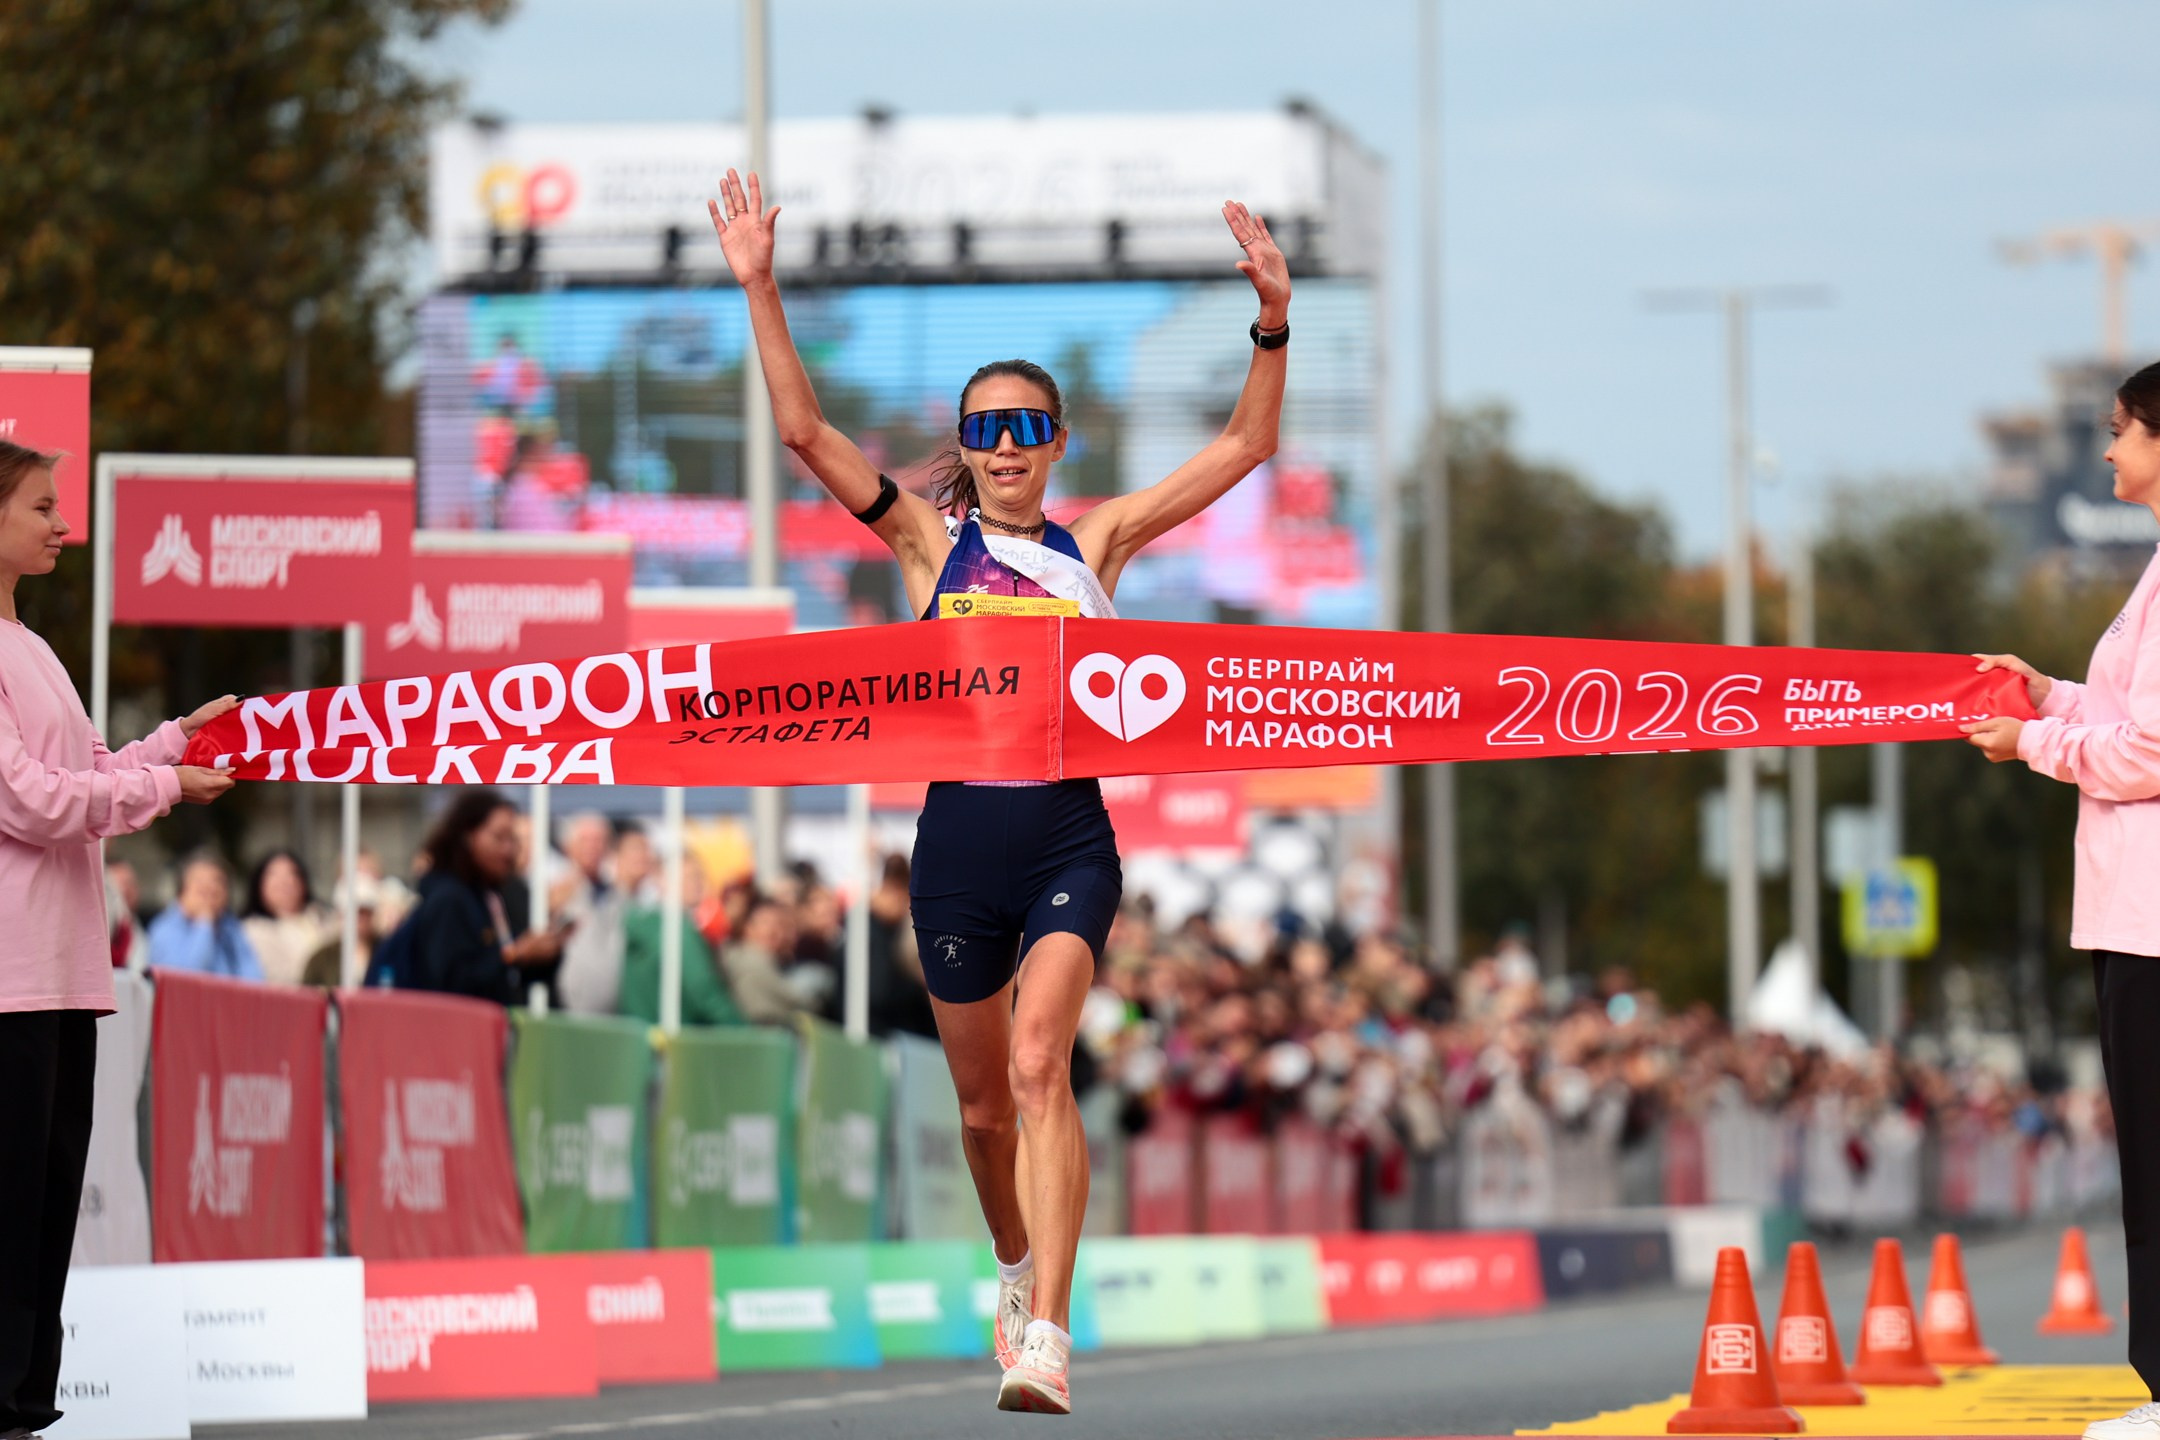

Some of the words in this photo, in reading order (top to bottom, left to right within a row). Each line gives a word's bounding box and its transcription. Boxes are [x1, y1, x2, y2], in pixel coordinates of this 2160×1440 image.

[210, 511, 381, 556] МОСКОВСКИЙ
[210, 552, 292, 589] СПОРТ
[976, 604, 1025, 612] МОСКОВСКИЙ
[1206, 657, 1394, 683] СБЕРПРАЙМ
[240, 643, 719, 752] МАРАФОН
[681, 666, 1020, 722] КОРПОРАТИВНАЯ
[1206, 686, 1461, 719] МОСКОВСКИЙ
[1486, 666, 1762, 745] 2026
[1784, 678, 1861, 703] БЫТЬ
[1785, 702, 1953, 723] ПРИМЕРОМ
[669, 716, 871, 745] ЭСТАФЕТА
[1206, 720, 1393, 748] МАРАФОН
[366, 1283, 538, 1334] ОСКОВСКИЙ
[366, 1333, 433, 1372] ПОРТ
[59, 1382, 110, 1400] квы
